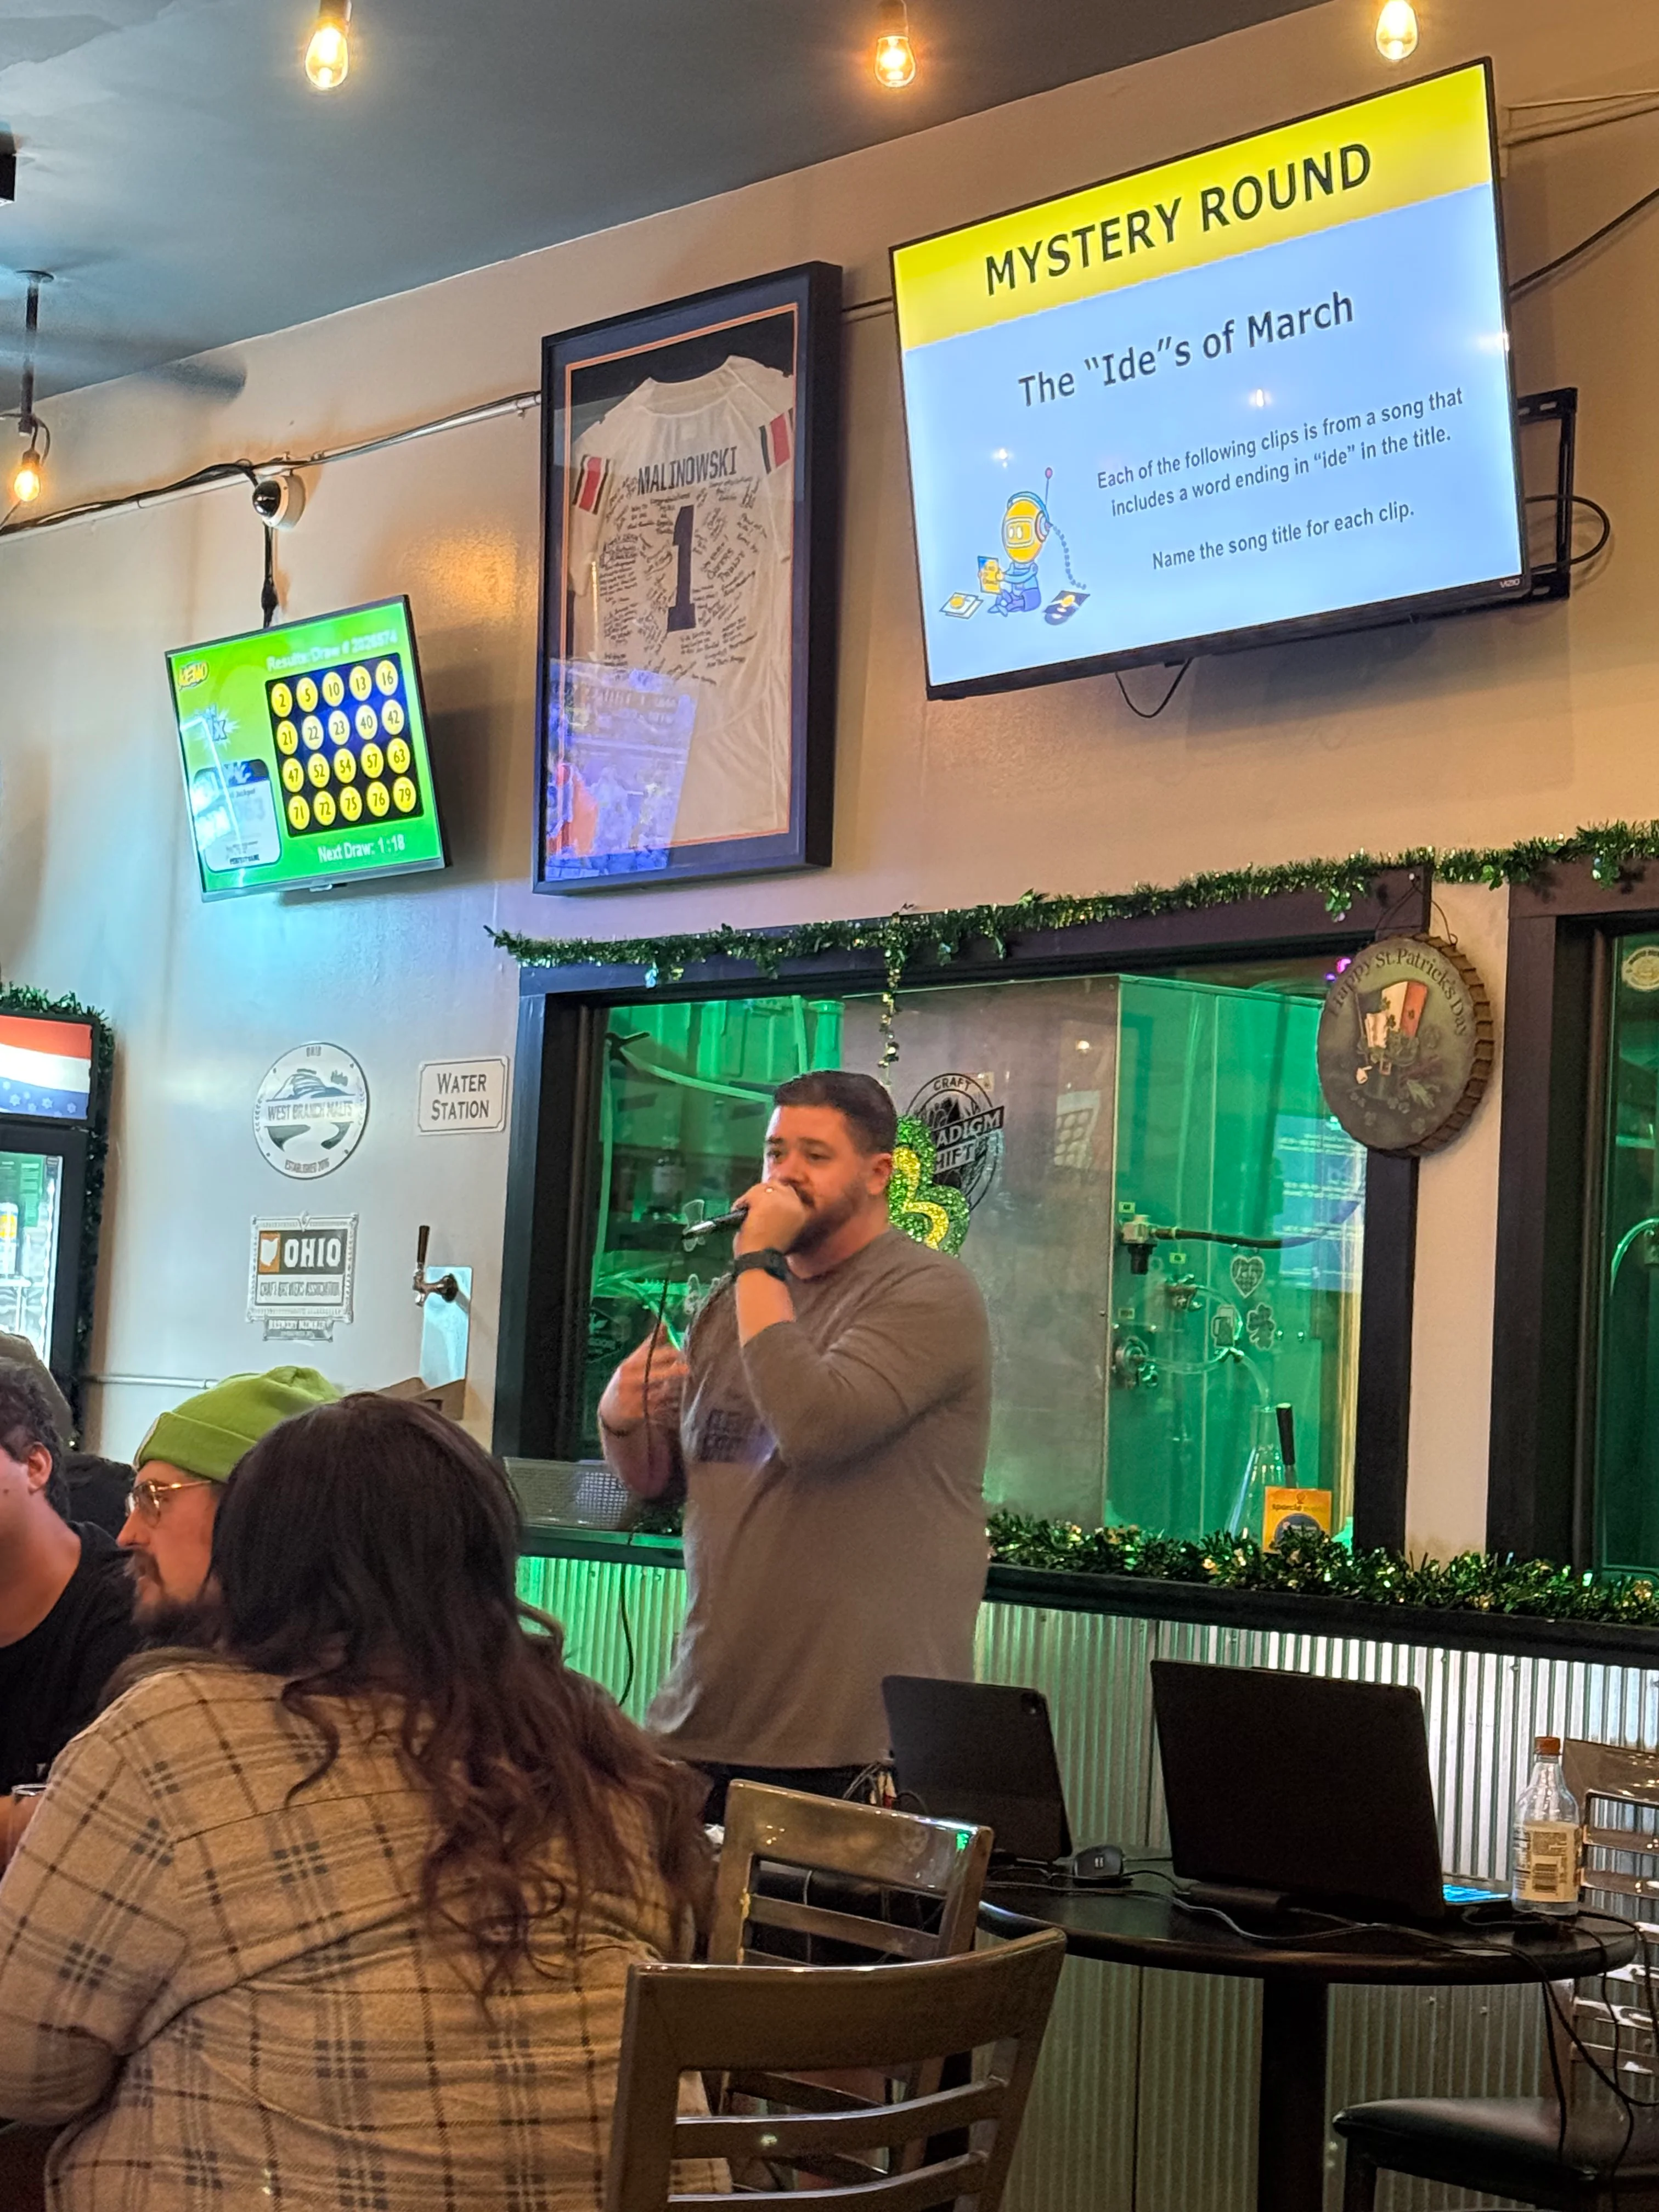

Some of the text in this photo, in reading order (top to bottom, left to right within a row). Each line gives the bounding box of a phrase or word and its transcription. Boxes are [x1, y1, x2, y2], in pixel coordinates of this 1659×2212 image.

[986, 143, 1371, 296] MYSTERY ROUND
[1018, 372, 1075, 407] The
[1203, 320, 1234, 359] of
[1248, 291, 1353, 347] March
[1097, 387, 1463, 489] Each of the following clips is from a song that
[637, 446, 738, 495] MALINOWSKI
[1111, 490, 1174, 517] includes
[1180, 487, 1188, 501] a
[1192, 473, 1231, 498] word
[1235, 464, 1289, 483] ending
[1294, 457, 1309, 475] in
[1361, 441, 1376, 460] in
[1382, 436, 1408, 455] the
[1413, 426, 1451, 448] title.
[1153, 501, 1414, 569] Name the song title for each clip.
[668, 505, 696, 632] 1
[1499, 578, 1521, 589] VIZIO
[279, 670, 394, 708] 2 5 10 13 16
[281, 709, 400, 746] 21 22 23 40 42
[288, 748, 406, 783] 47 52 54 57 63
[293, 787, 411, 820] 71 72 75 76 79
[317, 844, 343, 863] Next
[343, 842, 375, 859] Draw:
[1449, 998, 1469, 1036] Day
[437, 1073, 487, 1094] WATER
[933, 1078, 972, 1092] CRAFT
[268, 1101, 353, 1121] WEST BRANCH MALTS
[431, 1099, 489, 1121] STATION
[936, 1113, 1001, 1149] ADIGM
[936, 1143, 977, 1170] HIFT
[284, 1237, 341, 1268] OHIO
